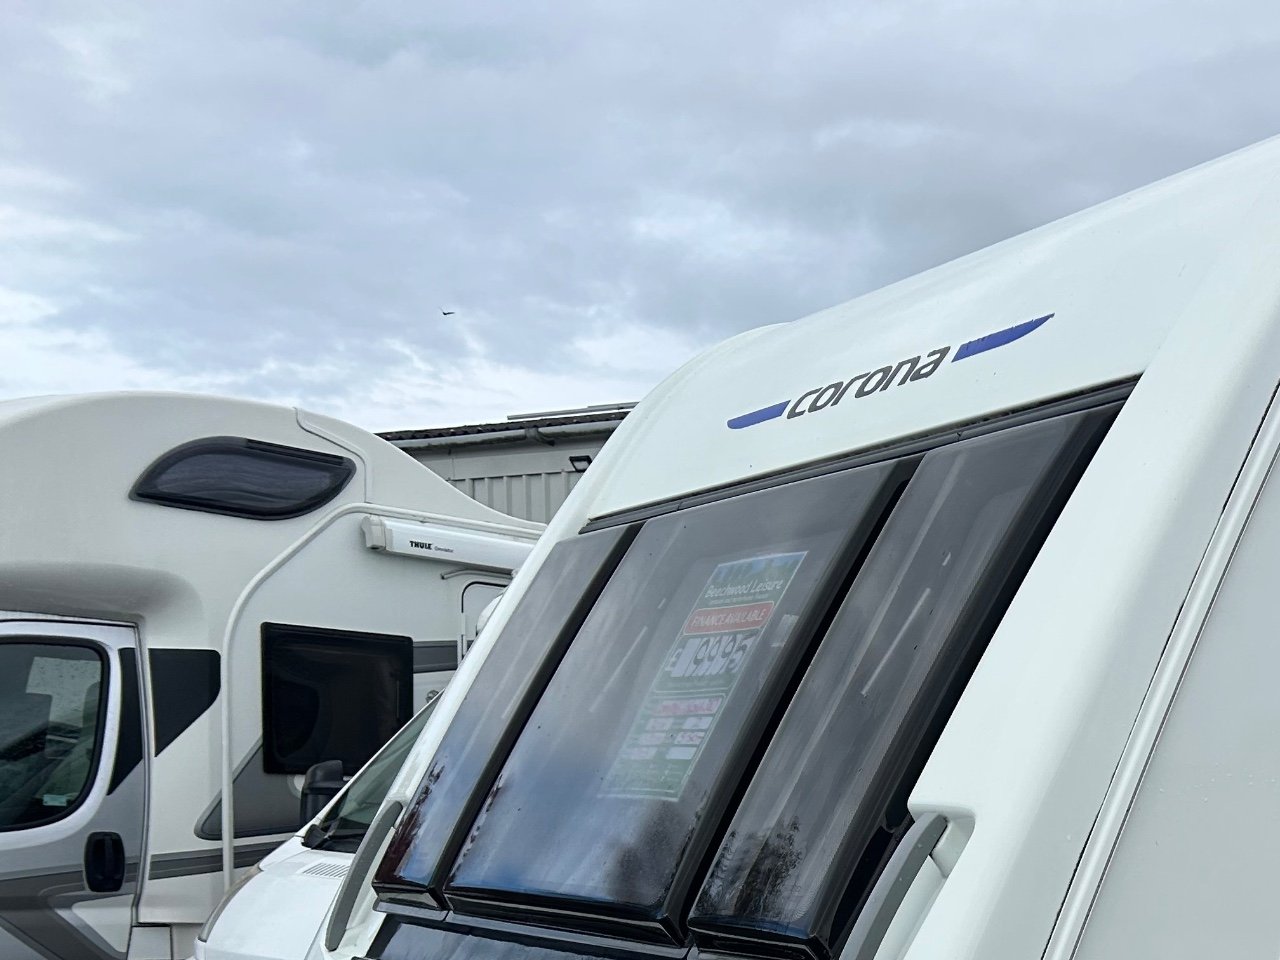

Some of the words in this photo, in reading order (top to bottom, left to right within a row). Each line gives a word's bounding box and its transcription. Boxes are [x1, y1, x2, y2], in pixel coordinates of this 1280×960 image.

[786, 345, 951, 420] corona
[409, 540, 433, 551] THULE
[750, 579, 783, 593] Leisure
[690, 614, 727, 627] FINANCE
[725, 608, 767, 624] AVAILABLE
